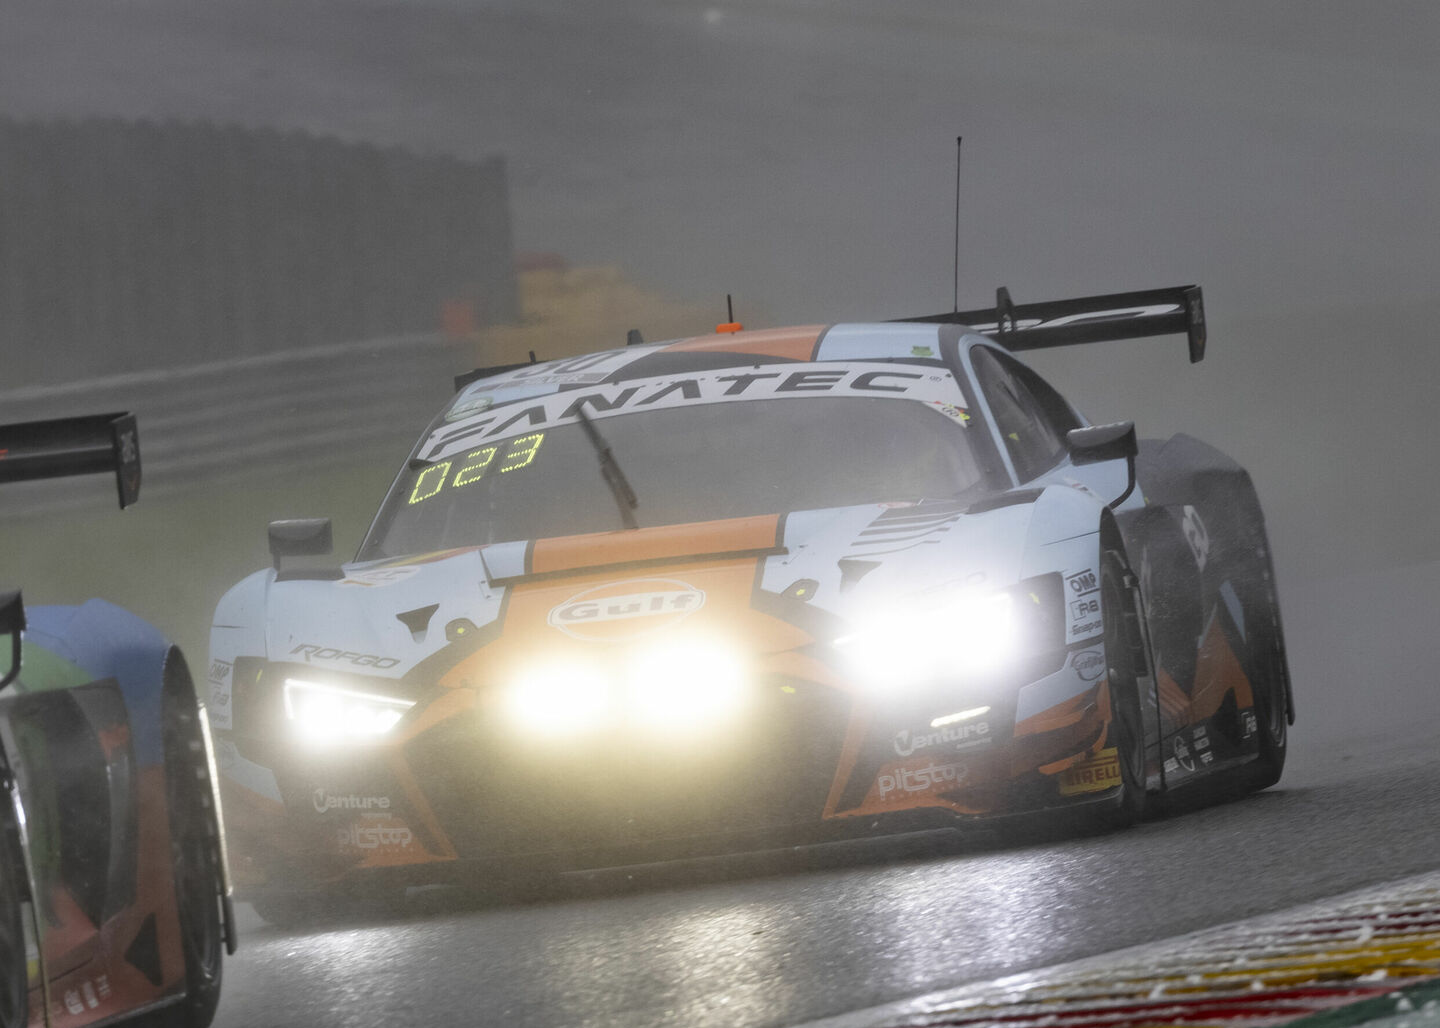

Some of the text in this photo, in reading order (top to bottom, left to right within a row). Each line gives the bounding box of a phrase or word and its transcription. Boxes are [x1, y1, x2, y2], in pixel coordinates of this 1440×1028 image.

[426, 371, 925, 461] FANATEC
[409, 433, 544, 504] 023
[558, 593, 696, 621] Gulf
[288, 643, 401, 669] ROFGO
